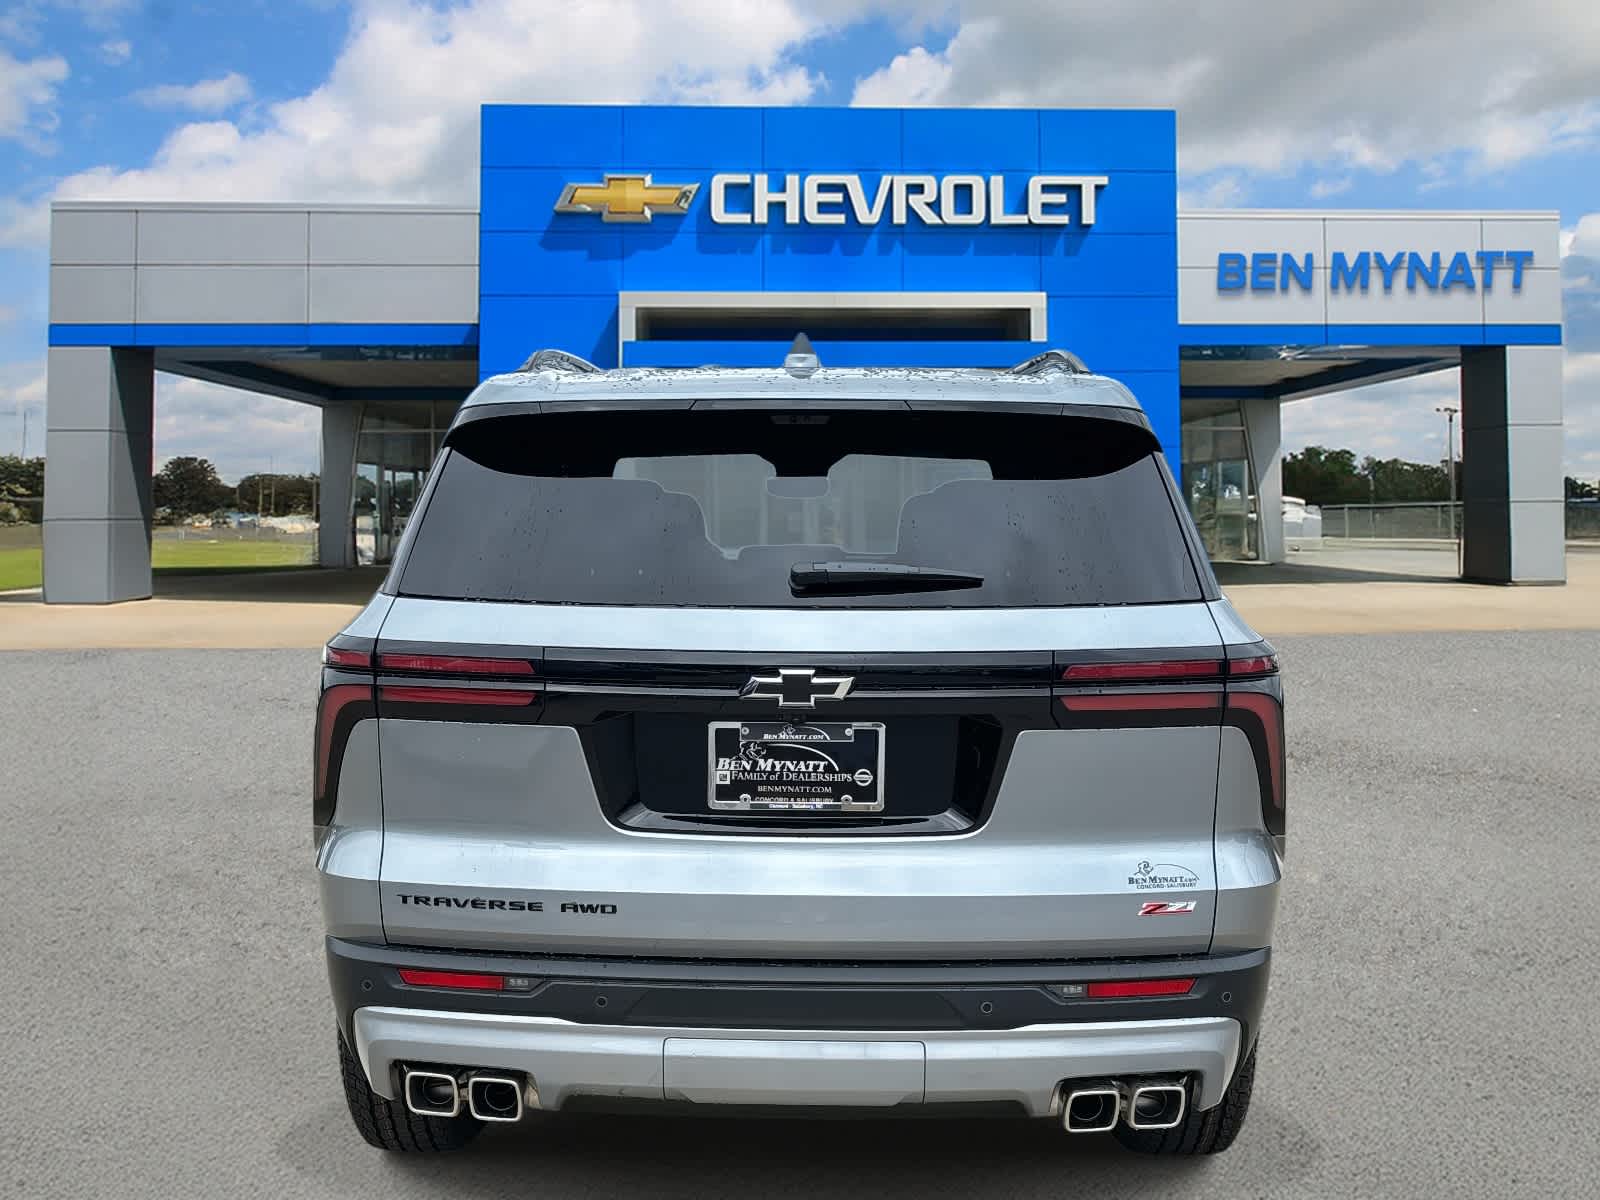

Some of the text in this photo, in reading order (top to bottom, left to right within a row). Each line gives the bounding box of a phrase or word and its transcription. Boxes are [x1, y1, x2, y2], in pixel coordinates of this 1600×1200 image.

[710, 173, 1109, 226] CHEVROLET
[1216, 250, 1534, 290] BEN MYNATT
[716, 758, 828, 772] BEN MYNATT
[757, 785, 832, 793] BENMYNATT.COM
[397, 894, 617, 914] TRAVERSE AWD
[1137, 901, 1197, 916] Z71
